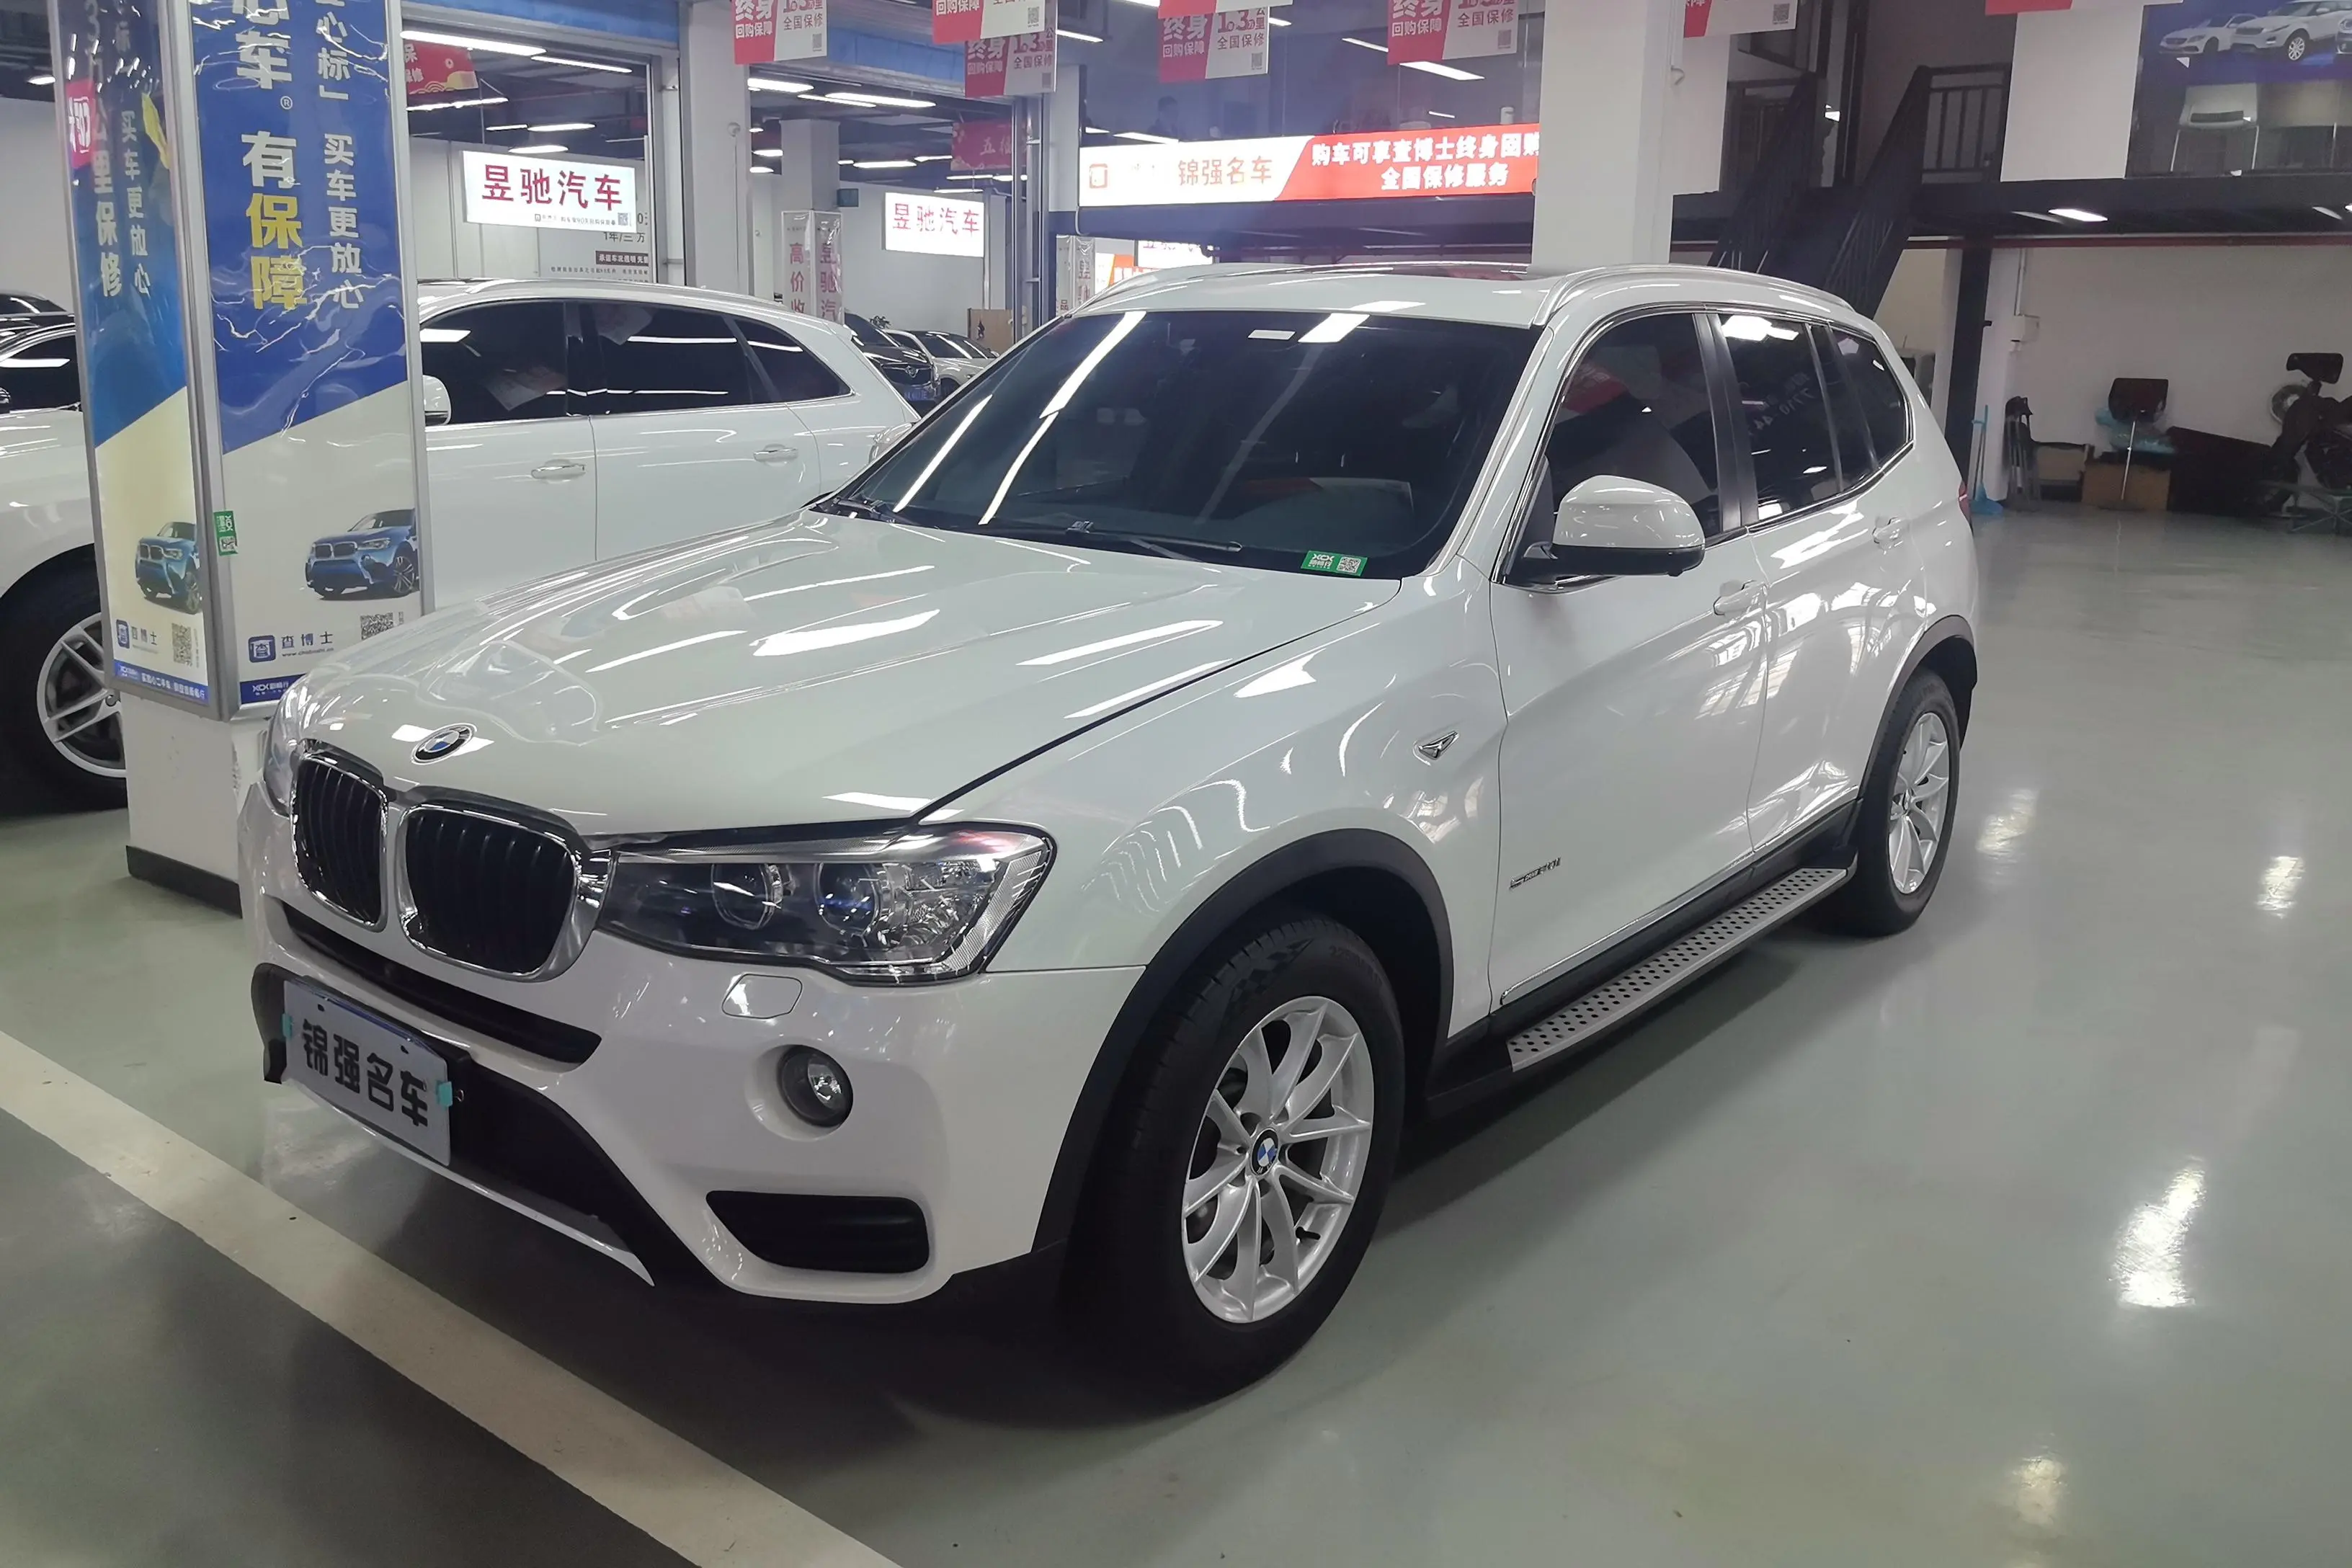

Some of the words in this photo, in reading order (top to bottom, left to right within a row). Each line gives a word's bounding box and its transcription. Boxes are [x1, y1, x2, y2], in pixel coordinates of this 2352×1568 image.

[935, 0, 980, 16] 回购保障
[1457, 9, 1514, 27] 全国保修
[735, 21, 773, 39] 回购保障
[783, 13, 823, 30] 全国保修
[1163, 14, 1208, 41] 终身
[1391, 18, 1442, 37] 回购保障
[1162, 40, 1204, 58] 回购保障
[1217, 33, 1265, 50] 全国保修
[1013, 54, 1053, 69] 全国保修
[1178, 156, 1273, 187] 锦强名车
[1380, 162, 1509, 190] 全国保修服务
[482, 164, 622, 211] 昱驰汽车
[241, 130, 308, 310] 有保障
[324, 133, 365, 308] 买车更放心
[893, 203, 979, 236] 昱驰汽车
[789, 242, 806, 313] 高价收
[281, 631, 333, 649] 查博士
[303, 1018, 428, 1127] 锦强名车
